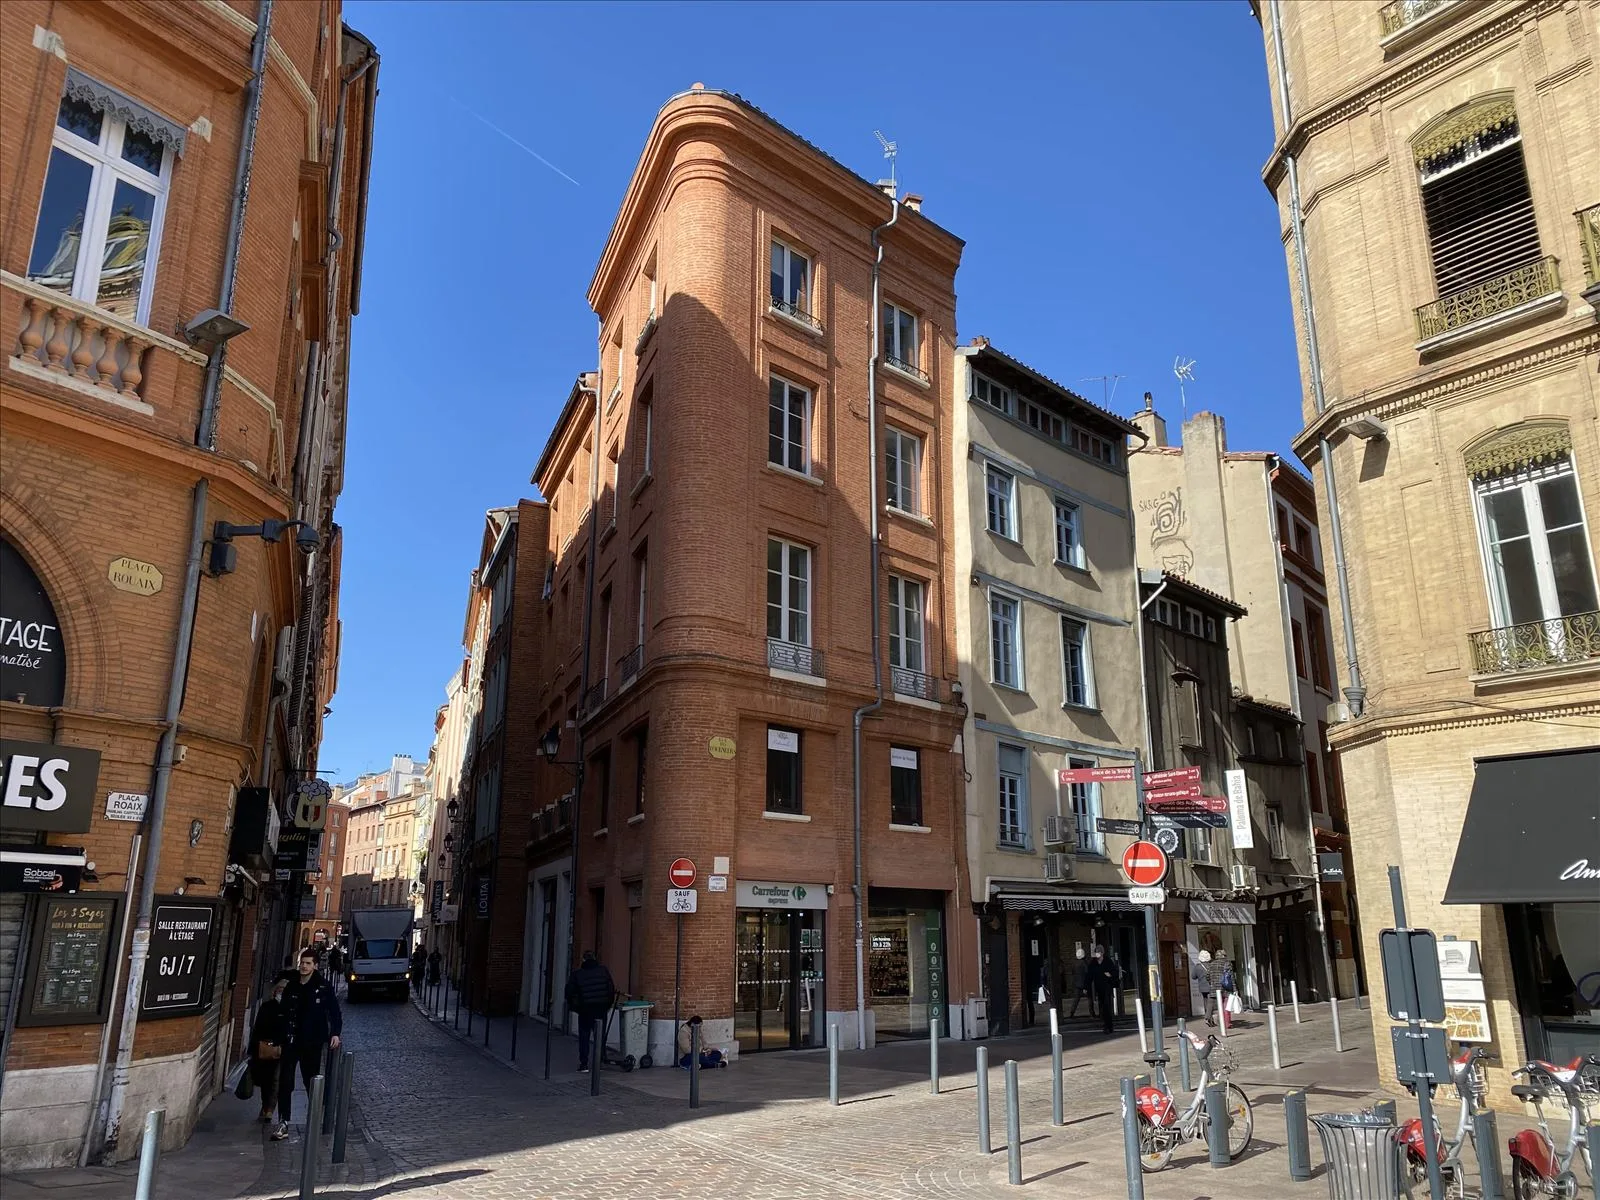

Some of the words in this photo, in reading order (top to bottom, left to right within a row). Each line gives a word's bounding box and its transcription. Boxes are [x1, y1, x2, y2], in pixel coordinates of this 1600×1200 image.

[121, 559, 151, 574] PLACE
[113, 571, 156, 591] ROUAIX
[0, 617, 56, 652] TAGE
[0, 754, 70, 811] ES
[118, 793, 141, 802] PLAÇA
[113, 800, 143, 811] ROAIX
[752, 885, 790, 897] Carrefour
[52, 907, 67, 919] Les
[71, 907, 78, 918] 3
[78, 907, 105, 922] Sages
[158, 921, 175, 930] SALLE
[175, 921, 208, 930] RESTAURANT
[168, 929, 173, 941] À
[173, 930, 195, 941] L'ÉTAGE
